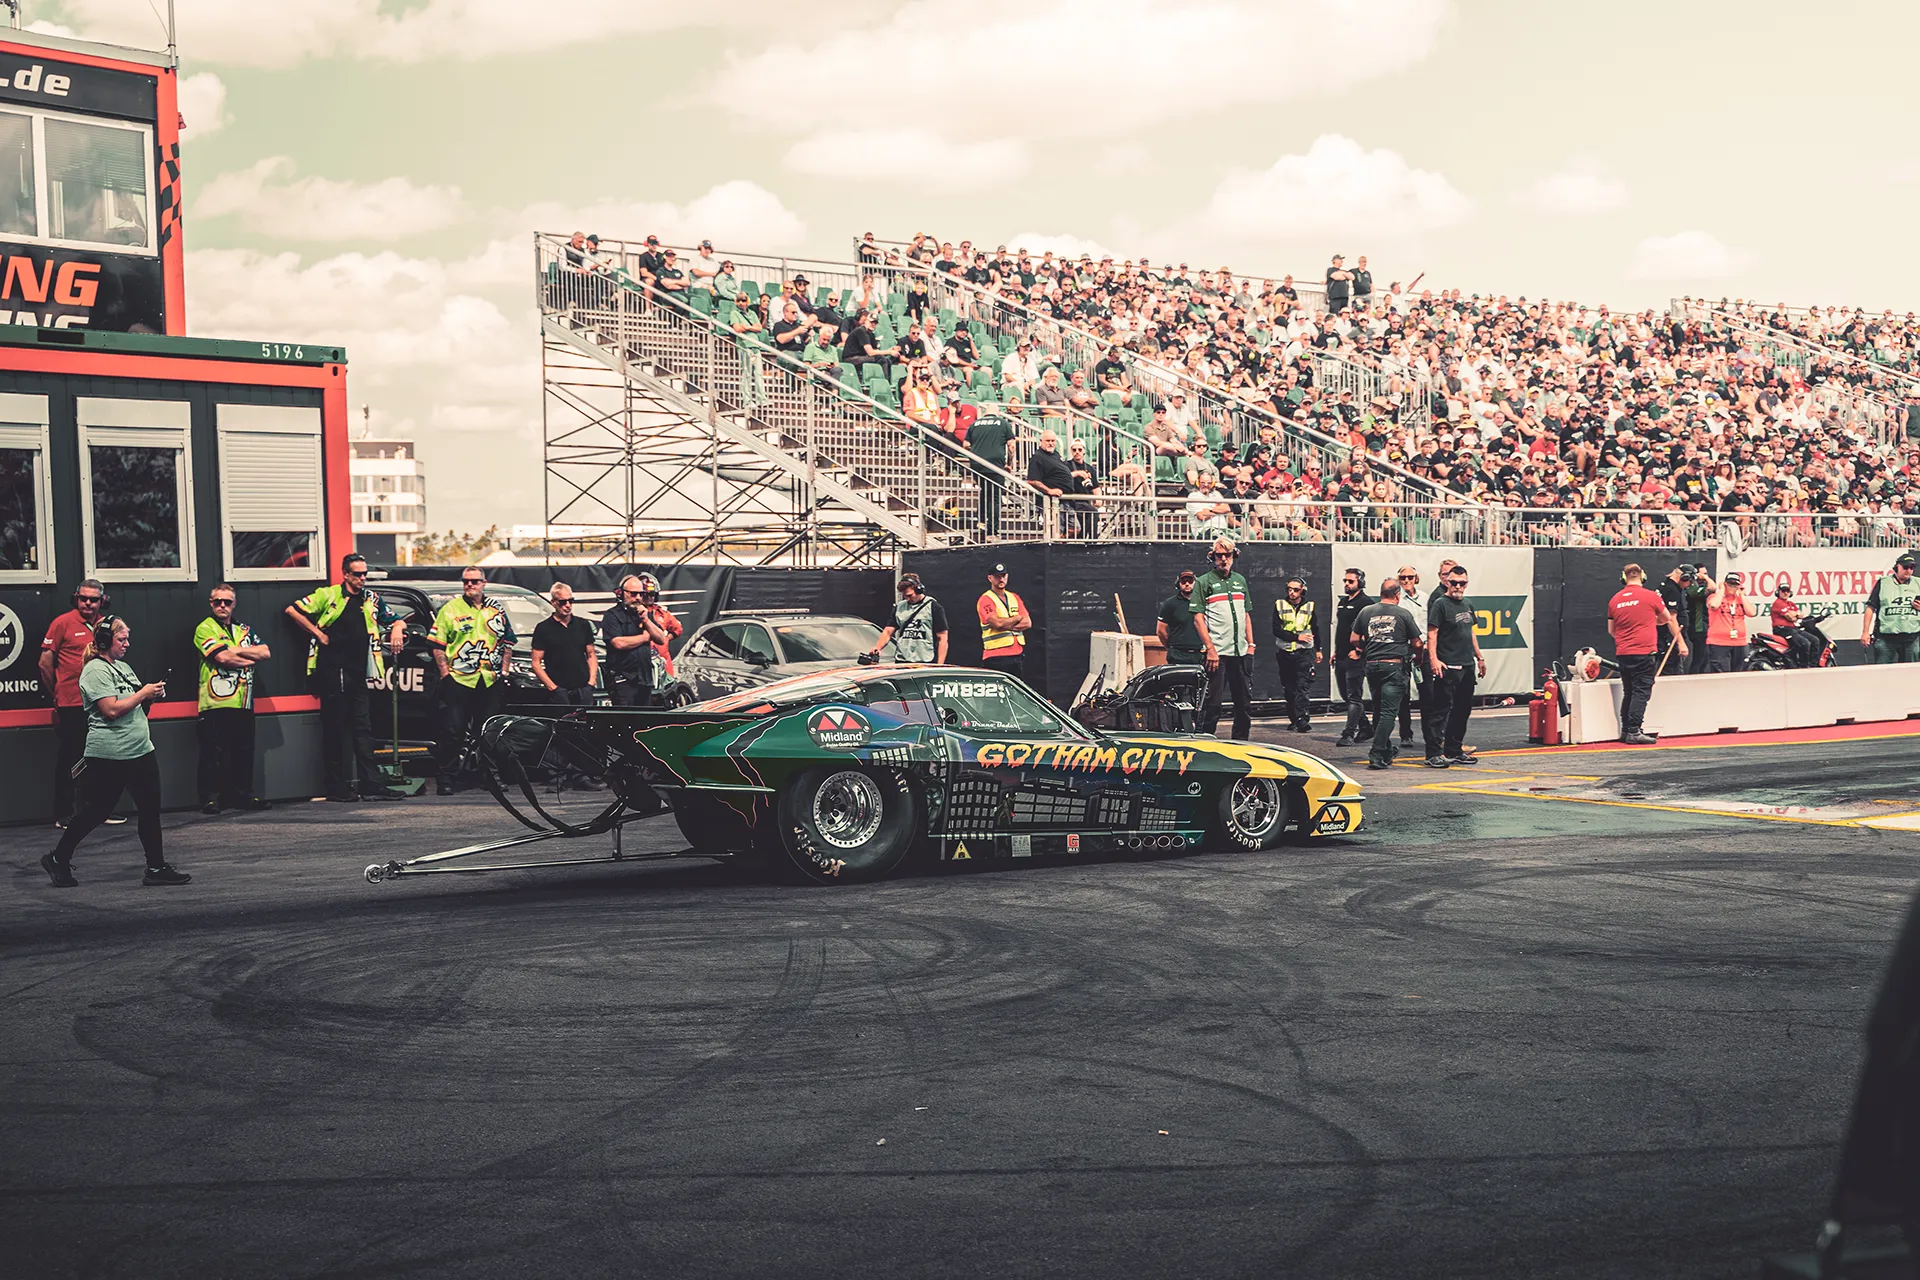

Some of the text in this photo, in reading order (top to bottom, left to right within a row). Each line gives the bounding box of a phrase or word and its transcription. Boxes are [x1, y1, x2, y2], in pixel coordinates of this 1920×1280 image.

[0, 254, 102, 307] NG
[261, 344, 304, 360] 5196
[1796, 570, 1895, 596] ANTHE
[1616, 599, 1640, 609] STAFF
[1886, 607, 1917, 617] MEDIA
[1471, 609, 1511, 636] OL
[931, 683, 998, 699] PM 832
[820, 732, 864, 743] Midland
[976, 742, 1196, 778] GOTHAM CITY
[1320, 822, 1346, 831] Midland
[1225, 820, 1263, 852] Hoosier
